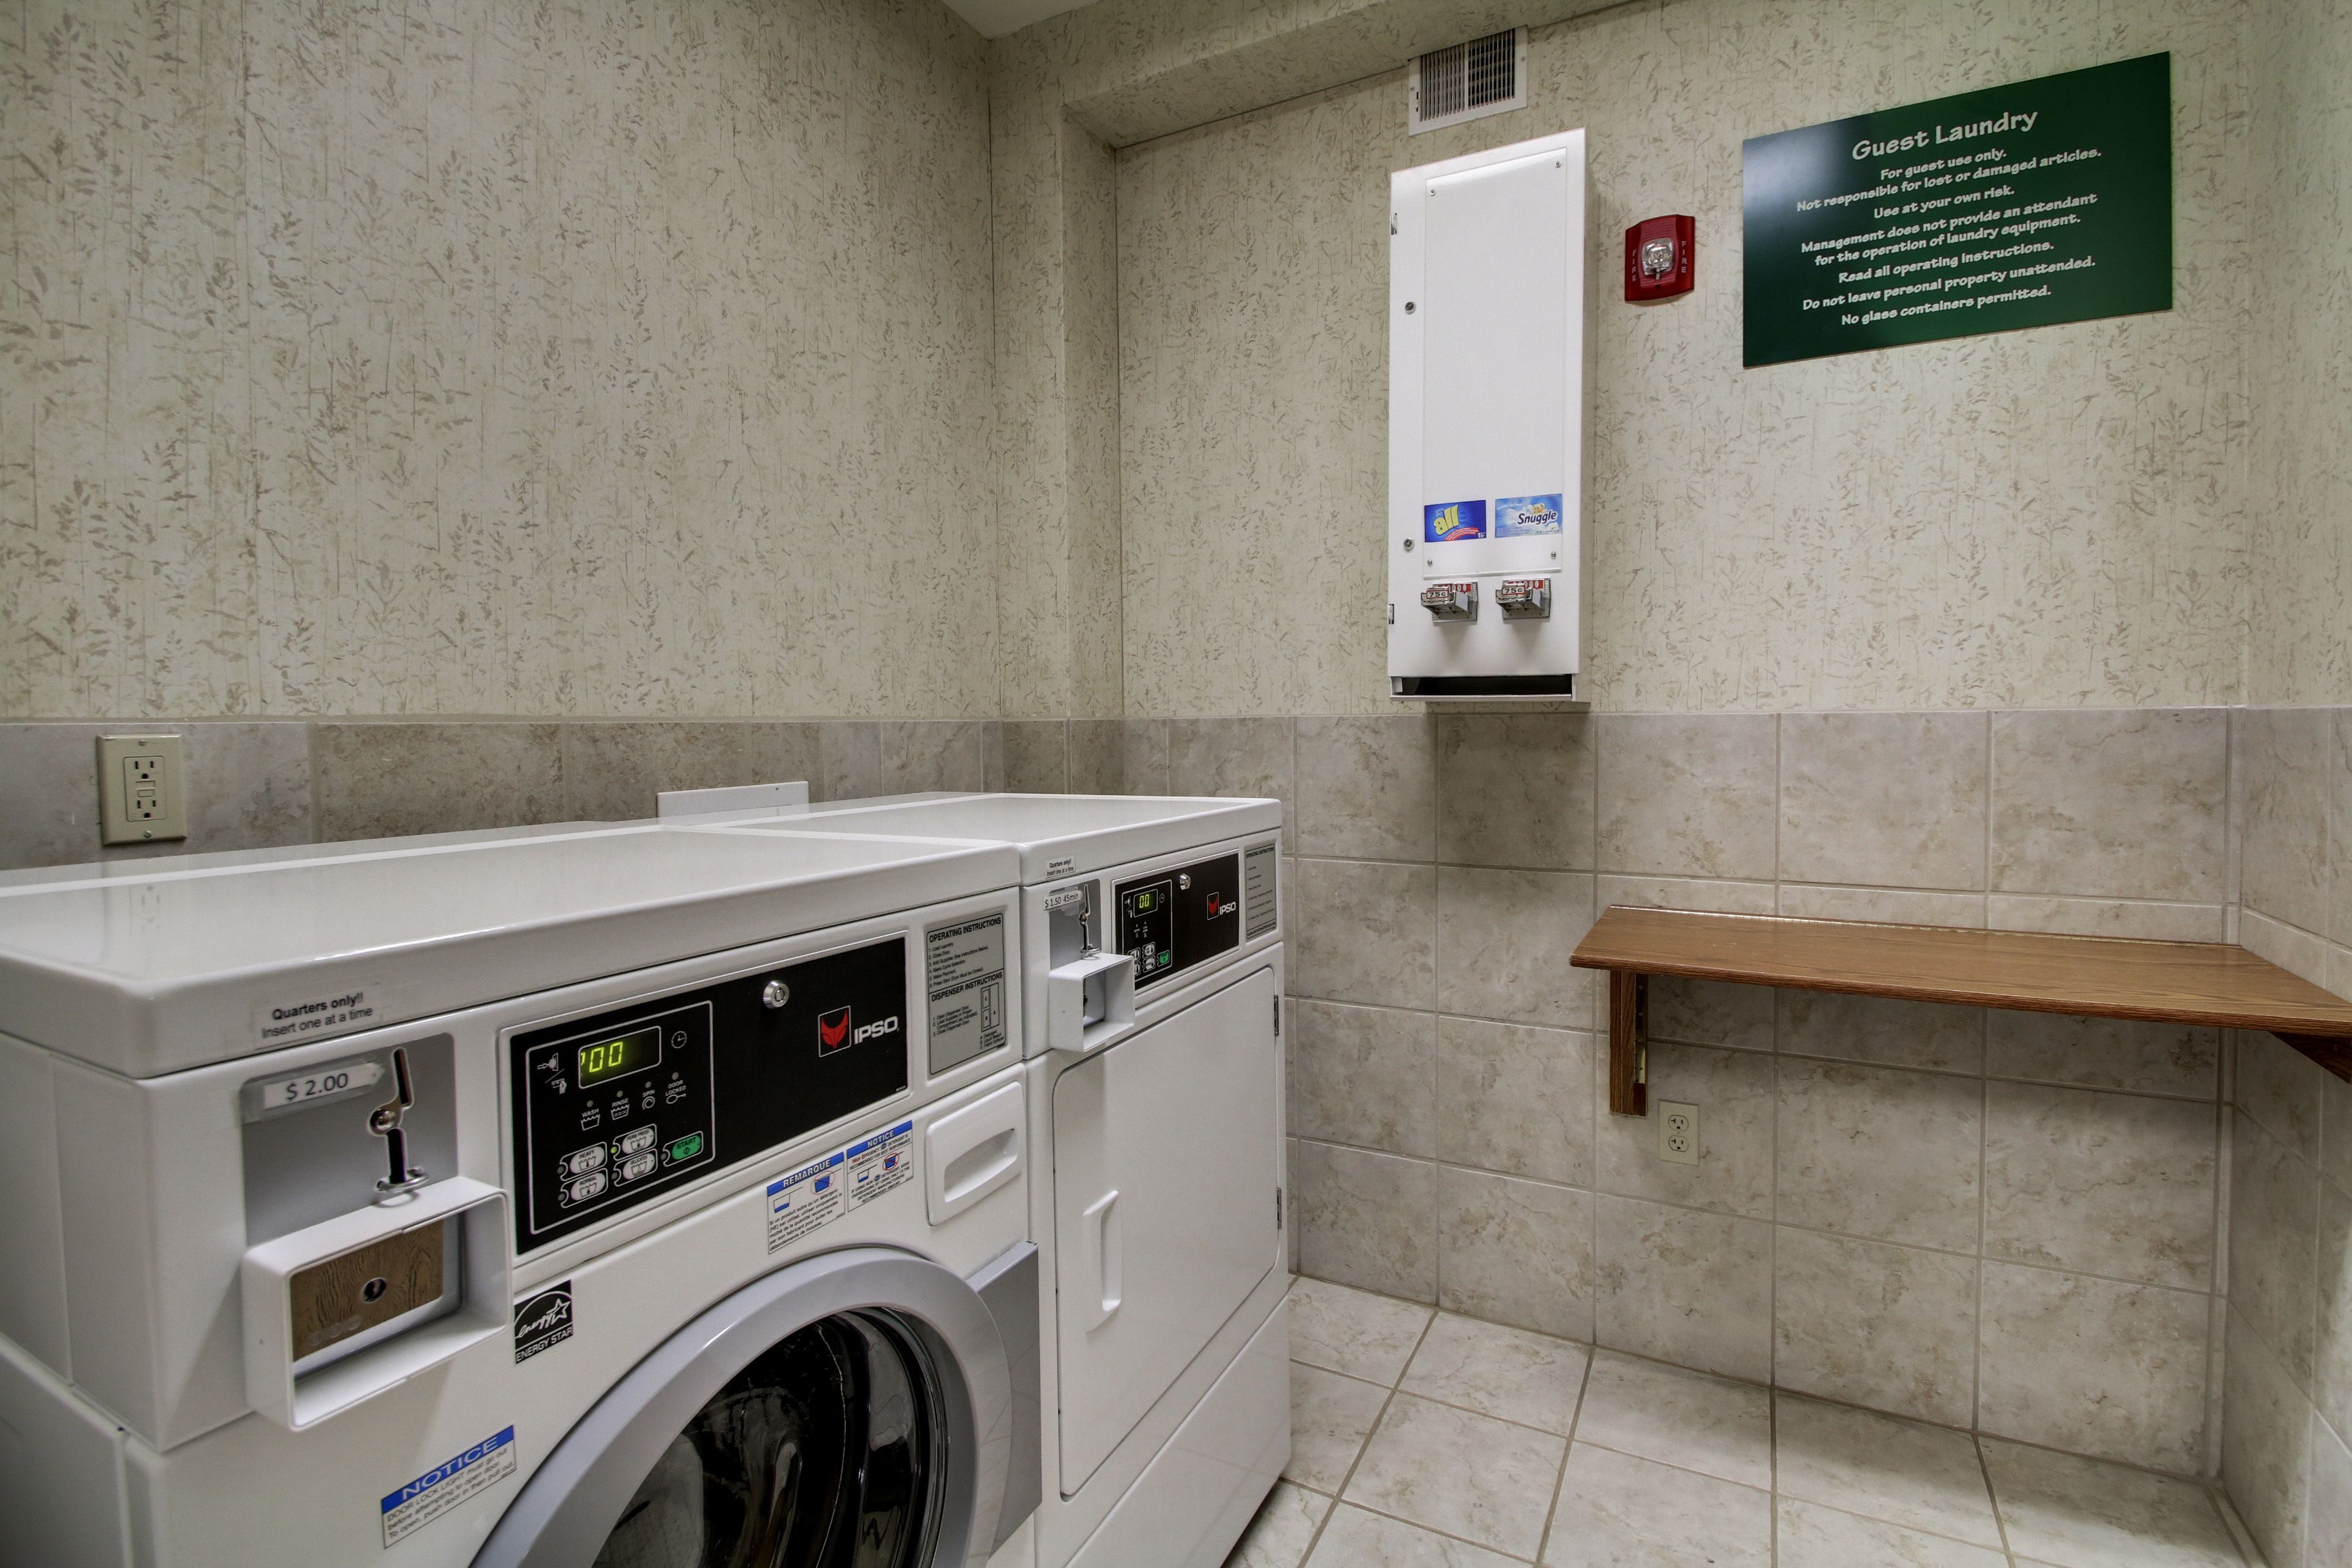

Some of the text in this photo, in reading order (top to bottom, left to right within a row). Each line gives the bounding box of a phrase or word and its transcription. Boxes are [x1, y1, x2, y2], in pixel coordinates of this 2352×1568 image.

[1852, 112, 2038, 160] Guest Laundry
[1880, 148, 2007, 180] For guest use only.
[1797, 148, 2102, 212] Not responsible for lost or damaged articles.
[1874, 185, 2015, 219] Use at your own risk.
[1801, 193, 2098, 253] Management does not provide an attendant
[1814, 213, 2081, 266] for the operation of laundry equipment.
[1839, 242, 2054, 283] Read all operating instructions.
[1803, 256, 2096, 310] Do not leave personal property unattended.
[1841, 285, 2052, 325] No glass containers permitted.
[1433, 504, 1459, 536] all
[1517, 510, 1557, 525] Snuggle
[1045, 893, 1079, 908] $ 1.50 45min
[1139, 894, 1150, 908] 00
[1219, 901, 1236, 916] IPSO
[930, 917, 1001, 941] OPERATING INSTRUCTIONS
[932, 973, 1001, 1000] DISPENSER INSTRUCTIONS
[272, 992, 364, 1020] Quarters only!!
[261, 1023, 297, 1039] Insert
[299, 1019, 321, 1030] one
[325, 1015, 336, 1026] at
[349, 1008, 373, 1020] time
[854, 1015, 898, 1045] IPSO
[286, 1073, 349, 1101] $ 2.00
[642, 1089, 655, 1097] SPIN
[665, 1086, 685, 1095] LOCKED
[667, 1080, 683, 1088] DOOR
[582, 1108, 598, 1117] WASH
[612, 1097, 628, 1107] RINSE
[676, 1138, 695, 1148] START
[867, 1130, 894, 1148] NOTICE
[783, 1160, 830, 1188] REMARQUE
[516, 1327, 573, 1362] ENERGY STAR
[402, 1436, 498, 1500] NOTICE
